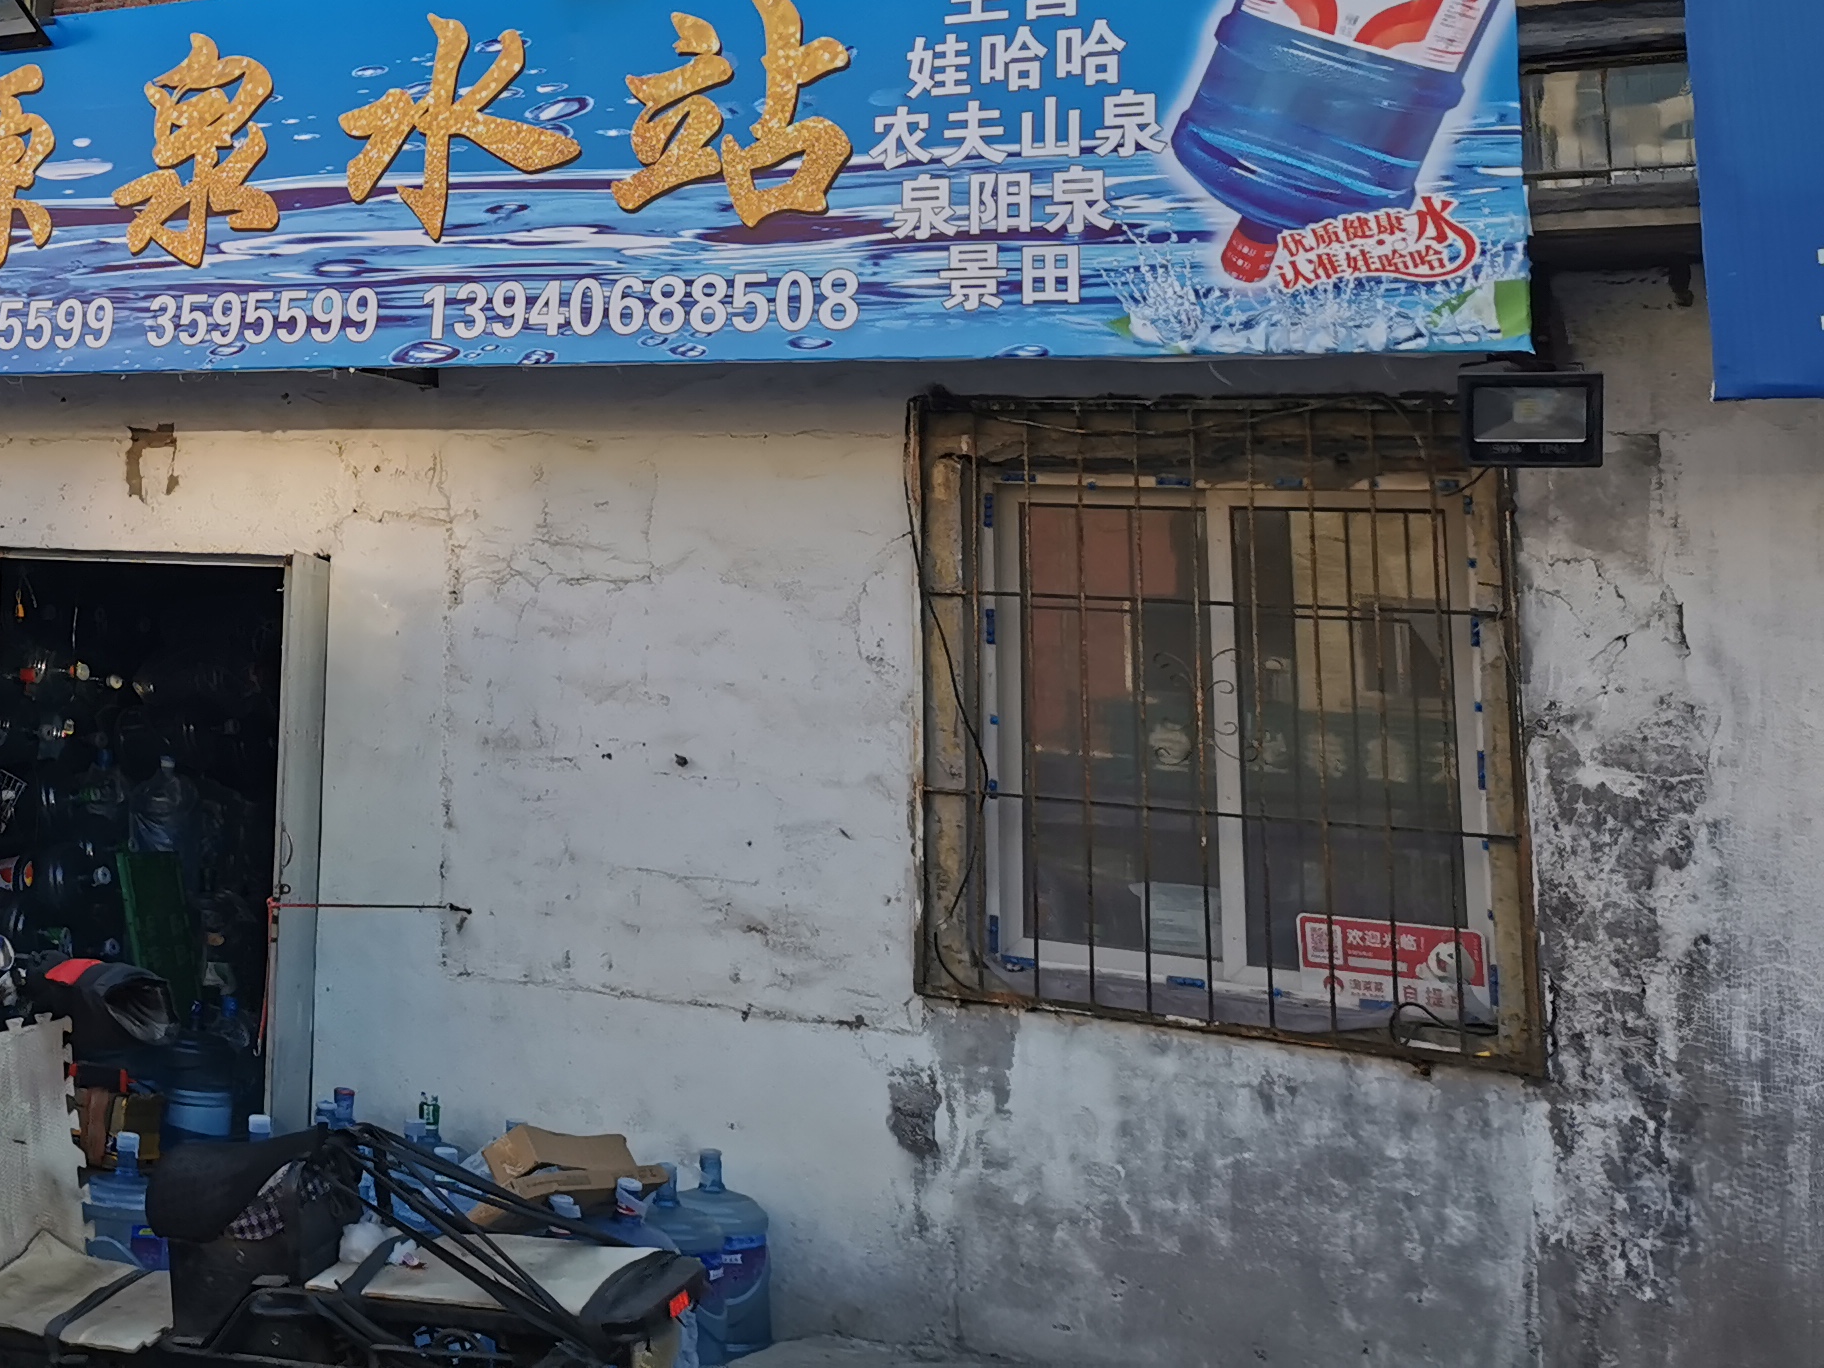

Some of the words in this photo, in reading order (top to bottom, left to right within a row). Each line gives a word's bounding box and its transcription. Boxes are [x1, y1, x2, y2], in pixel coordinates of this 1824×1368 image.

[906, 18, 1127, 100] 娃哈哈
[869, 88, 1168, 171] 农夫山泉
[892, 165, 1118, 240] 泉阳泉
[940, 244, 1082, 312] 景田
[1277, 244, 1446, 289] 认准娃哈哈
[147, 286, 379, 349] 3595599
[421, 267, 860, 341] 13940688508
